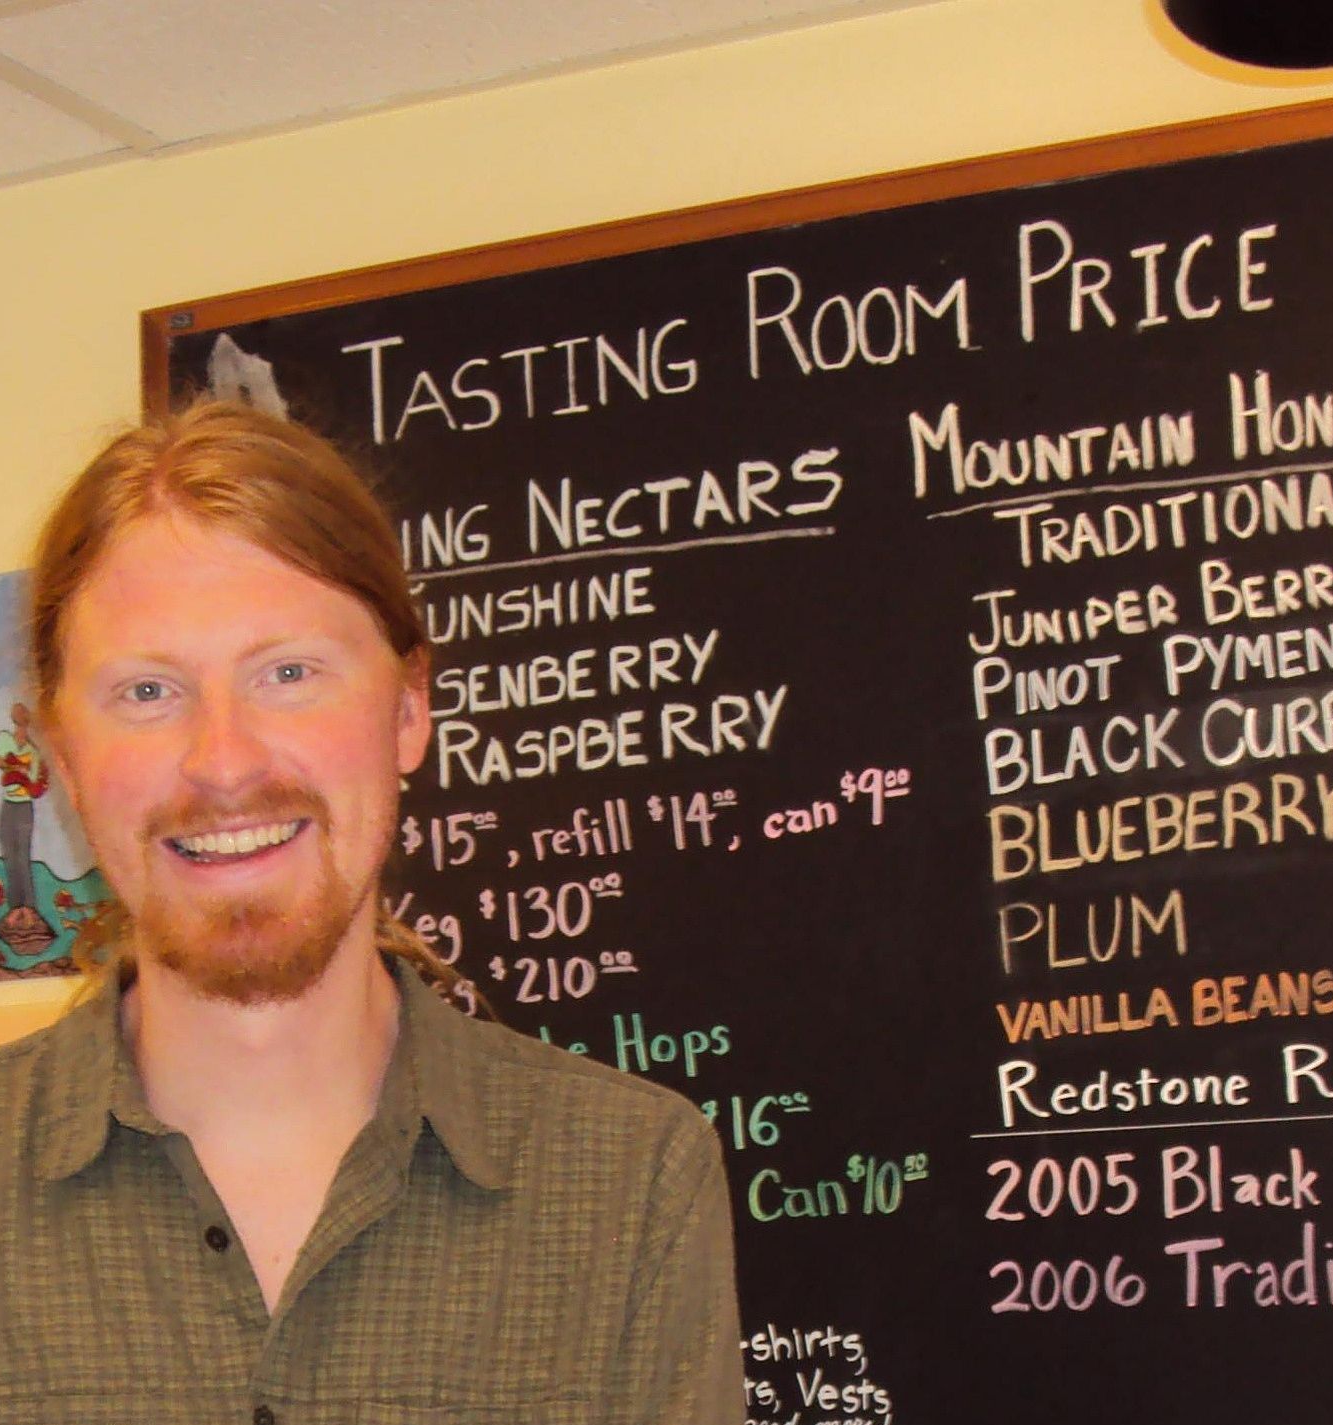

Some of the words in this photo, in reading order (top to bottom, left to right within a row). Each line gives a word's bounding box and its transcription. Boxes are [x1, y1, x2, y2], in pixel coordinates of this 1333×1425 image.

[341, 318, 699, 445] TASTING
[747, 265, 972, 379] ROOM
[1018, 219, 1278, 342] PRICE
[908, 402, 1195, 499] MOUNTAIN
[403, 504, 491, 571] ING
[527, 446, 842, 554] NECTARS
[409, 566, 657, 645] UNSHINE
[969, 584, 1179, 655] JUNIPER
[431, 628, 720, 719] SENBERRY
[972, 653, 1122, 720] PINOT
[438, 684, 788, 790] RASPBERRY
[983, 706, 1187, 796] BLACK
[530, 797, 633, 863] refill
[762, 800, 839, 840] can
[998, 888, 1188, 975] PLUM
[612, 1012, 732, 1079] Hops
[995, 986, 1180, 1045] VANILLA
[997, 1059, 1251, 1128] Redstone
[747, 1168, 849, 1224] Can
[984, 1151, 1140, 1222] 2005
[1161, 1144, 1322, 1220] Black
[989, 1254, 1147, 1315] 2006
[739, 1323, 867, 1376] -shirts,
